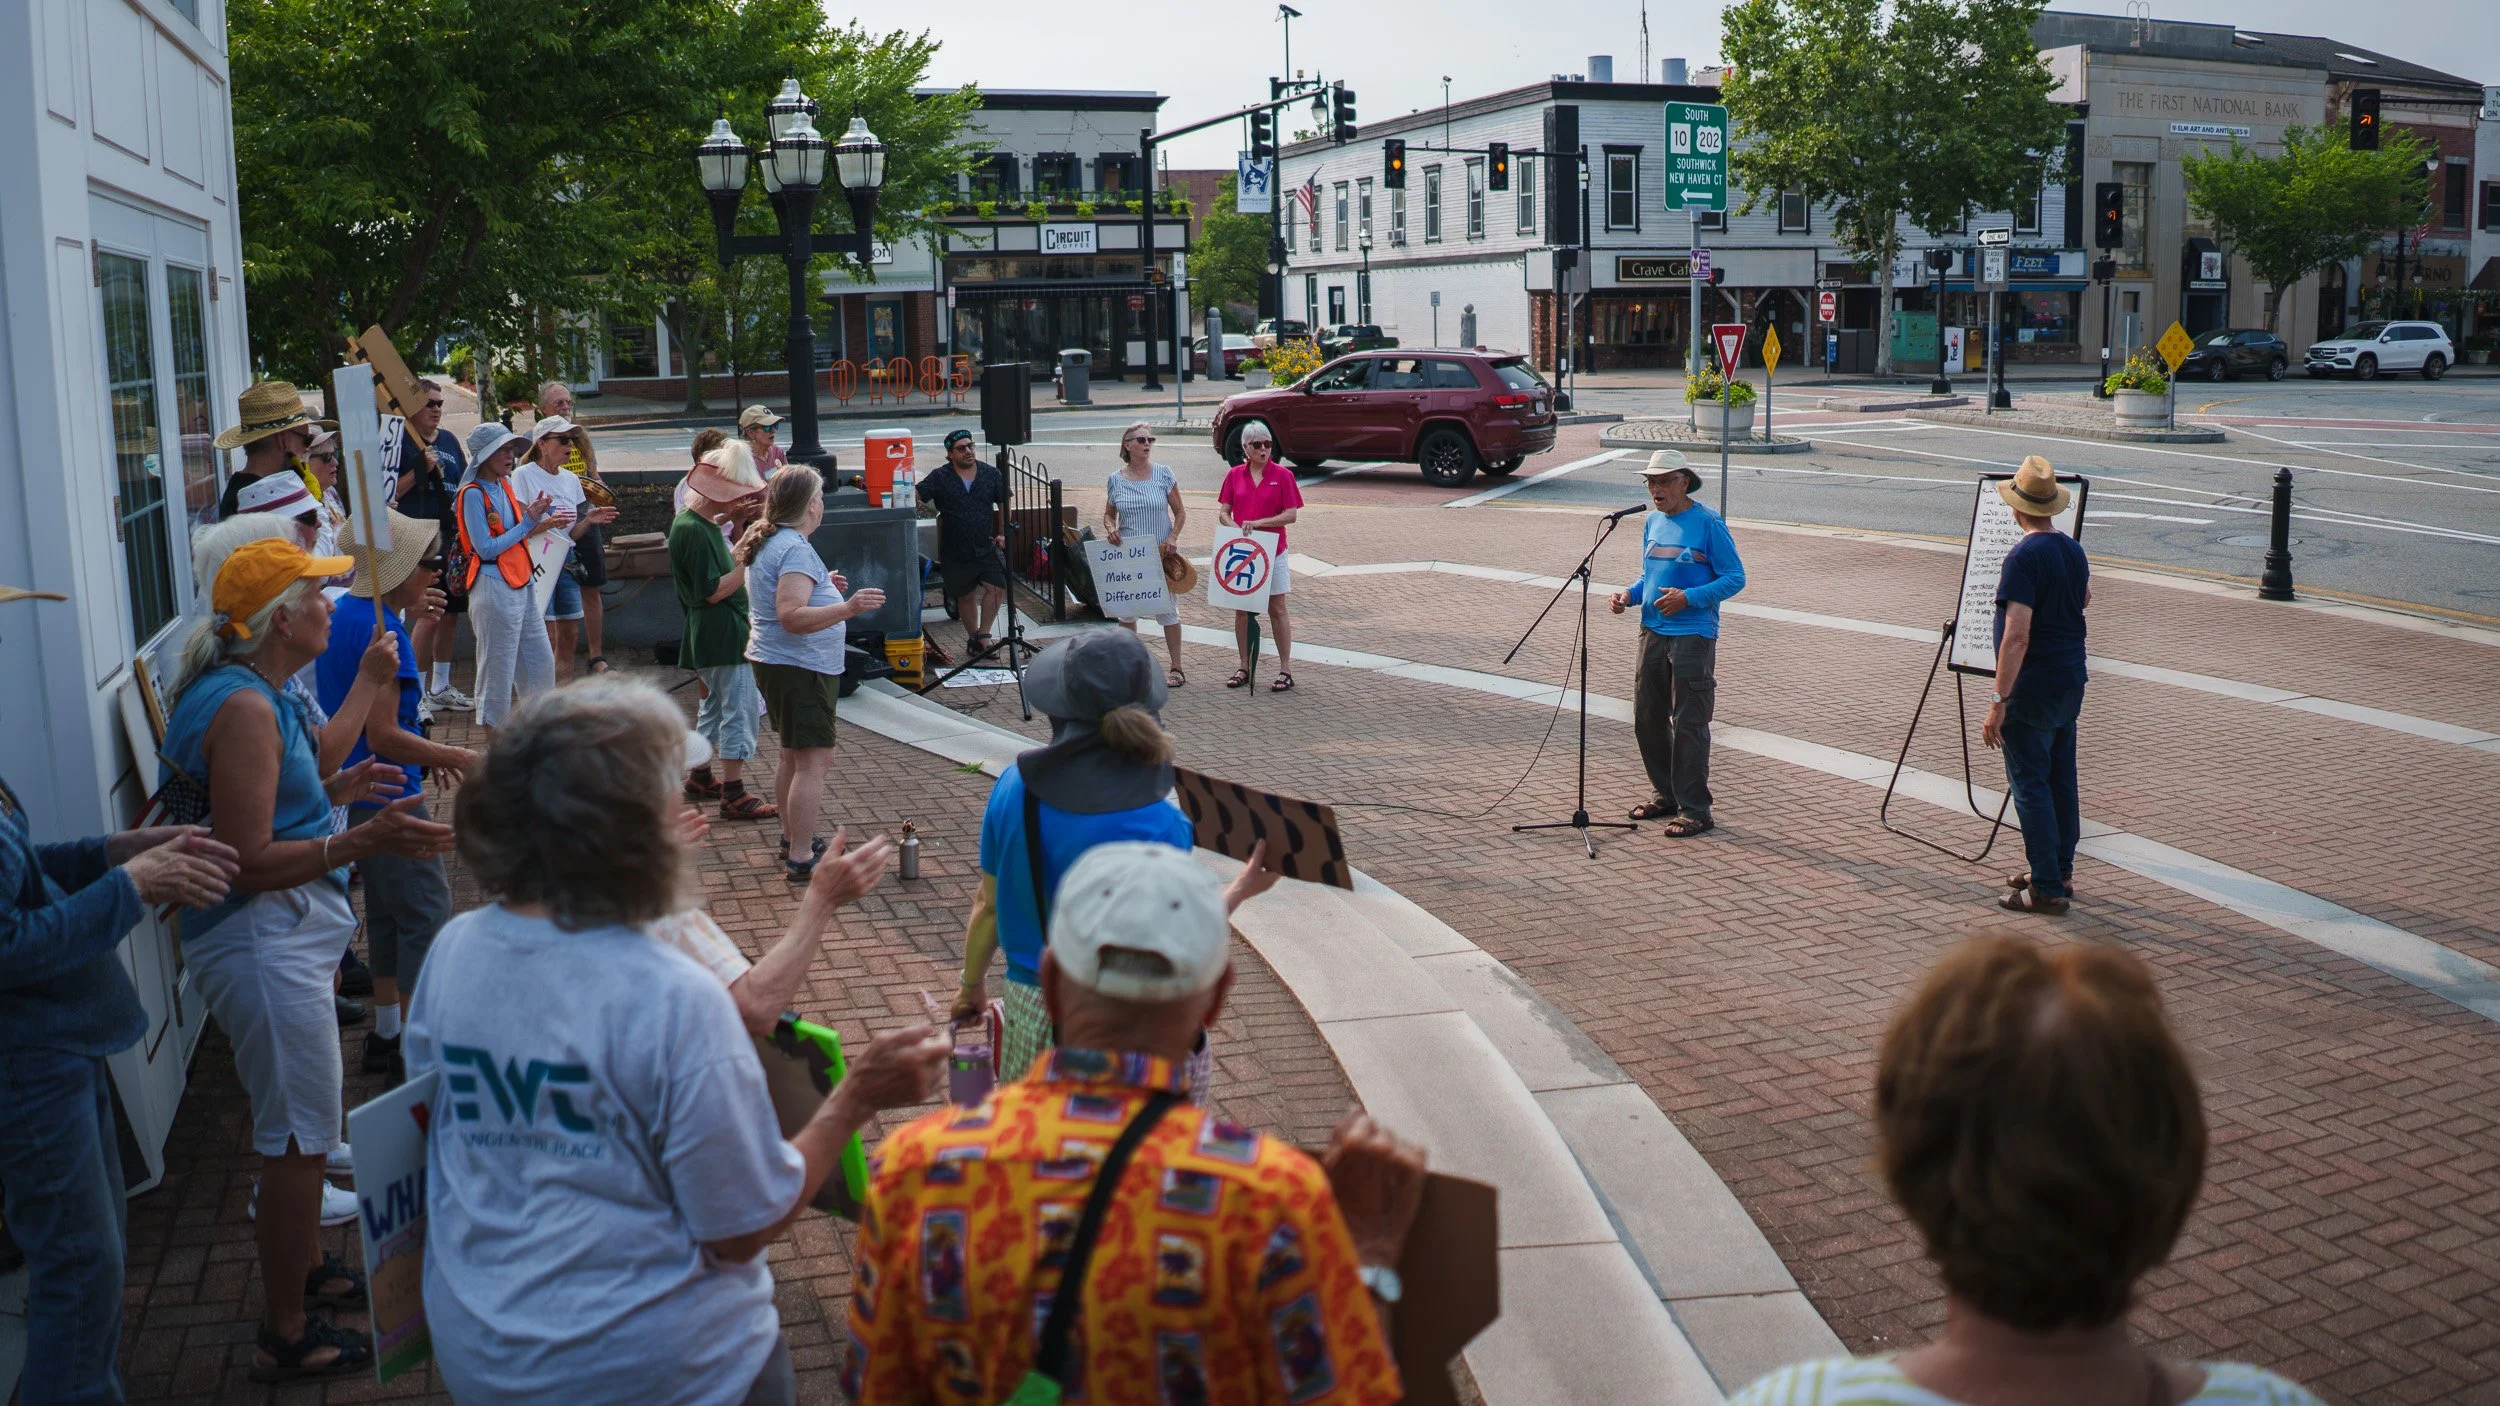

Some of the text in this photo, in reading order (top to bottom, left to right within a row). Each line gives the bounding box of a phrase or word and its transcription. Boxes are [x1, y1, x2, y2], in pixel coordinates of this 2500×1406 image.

[2118, 92, 2299, 118] THE FIRST NATIONAL BANK
[1685, 107, 1709, 121] SOUTH
[1674, 130, 1687, 147] 10
[1699, 131, 1719, 148] 202
[1676, 158, 1716, 171] SOUTHWICK
[1669, 172, 1722, 186] NEW HAVEN CT
[1046, 229, 1091, 250] CIRCUIT
[1632, 262, 1691, 276] Crave Caf
[2015, 255, 2045, 268] FEET
[1950, 331, 1959, 361] FedEx
[830, 354, 973, 404] 01085
[1100, 547, 1146, 562] Join Us!
[1224, 544, 1256, 590] ICE
[1105, 571, 1143, 584] Make a
[1105, 587, 1162, 603] Difference!
